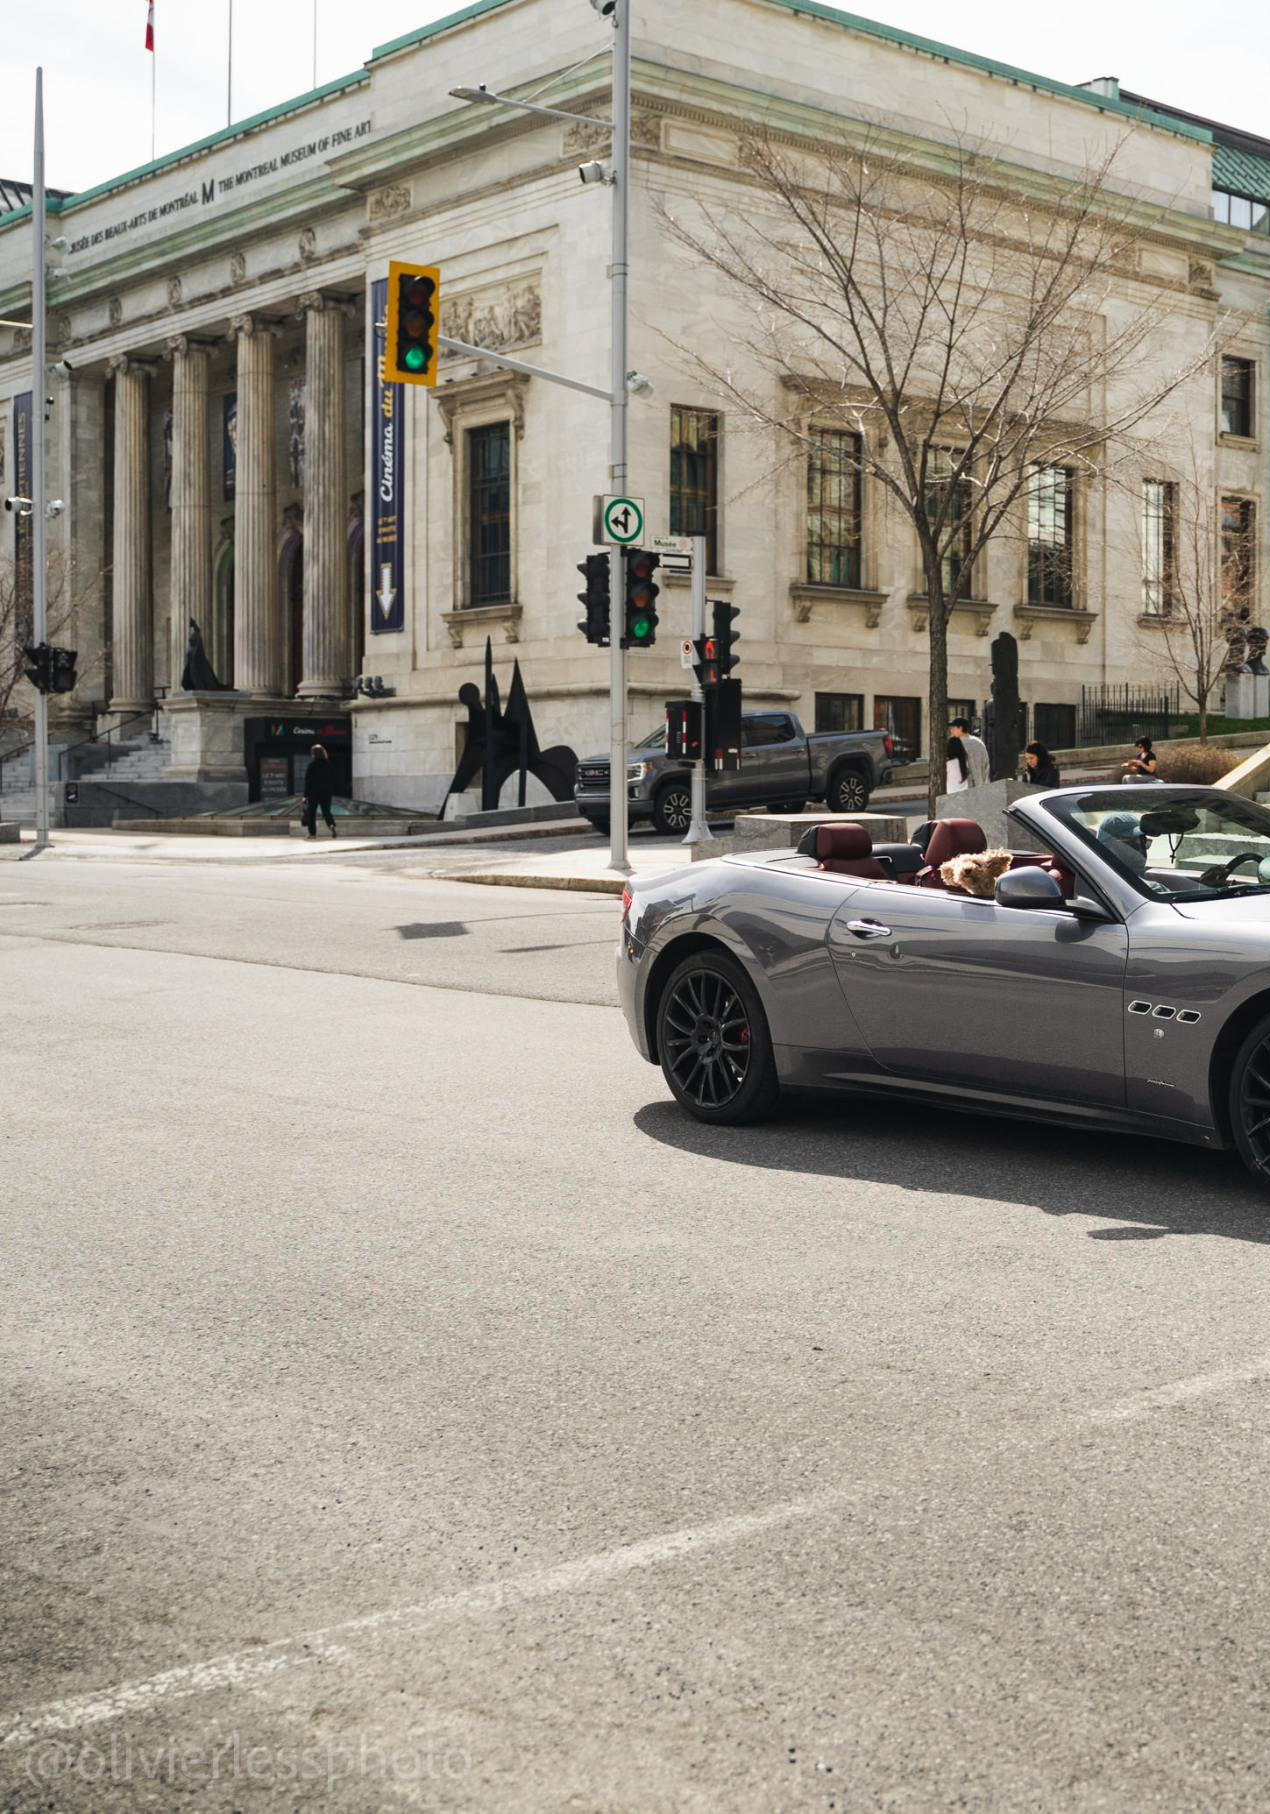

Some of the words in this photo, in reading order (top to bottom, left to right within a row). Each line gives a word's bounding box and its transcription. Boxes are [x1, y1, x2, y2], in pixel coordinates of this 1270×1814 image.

[218, 176, 235, 193] THE
[235, 158, 279, 186] MONTREAL
[280, 142, 316, 168] MUSEUM
[317, 136, 330, 153] OF
[331, 130, 353, 148] FINE
[354, 120, 371, 139] ART
[91, 231, 104, 246] DES
[105, 212, 147, 240] BEAUX-ARTS
[148, 209, 158, 222] DE
[159, 191, 199, 217] MONTRÉAL
[381, 388, 393, 418] du
[380, 423, 394, 502] Cinéma
[654, 540, 677, 548] Musée
